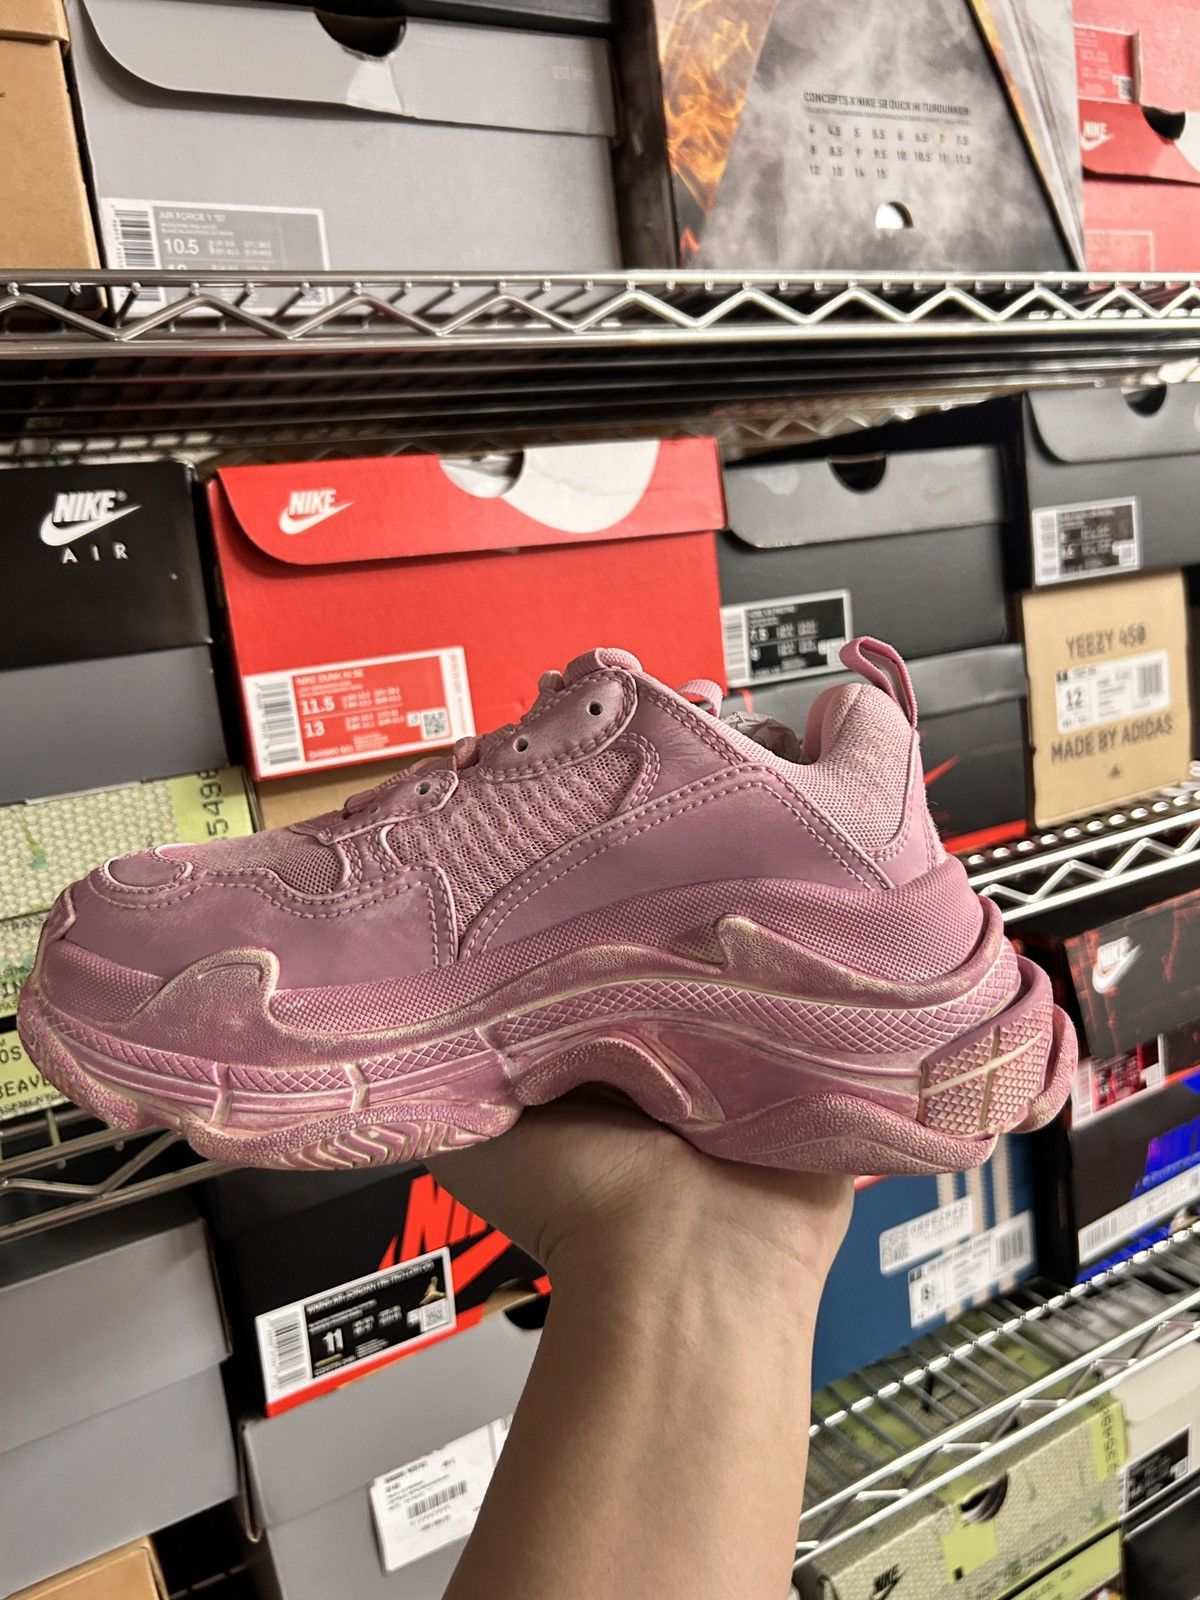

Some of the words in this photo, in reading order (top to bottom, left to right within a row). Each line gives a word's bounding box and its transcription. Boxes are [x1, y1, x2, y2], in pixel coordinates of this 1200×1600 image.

[803, 92, 849, 106] CONCEPTS
[857, 97, 876, 108] NIKE
[175, 212, 206, 221] FORCE
[163, 238, 200, 255] 10.5
[53, 490, 117, 522] NIKE
[288, 489, 337, 515] NIKE
[62, 541, 128, 564] AIR
[1065, 629, 1113, 659] YEEZY
[1119, 623, 1146, 647] 450
[302, 697, 335, 715] 11.5
[1065, 687, 1083, 711] 12
[304, 720, 326, 738] 13
[1051, 732, 1095, 763] MADE
[1098, 726, 1117, 751] BY
[1121, 711, 1173, 746] ADIDAS
[322, 1327, 344, 1354] 11
